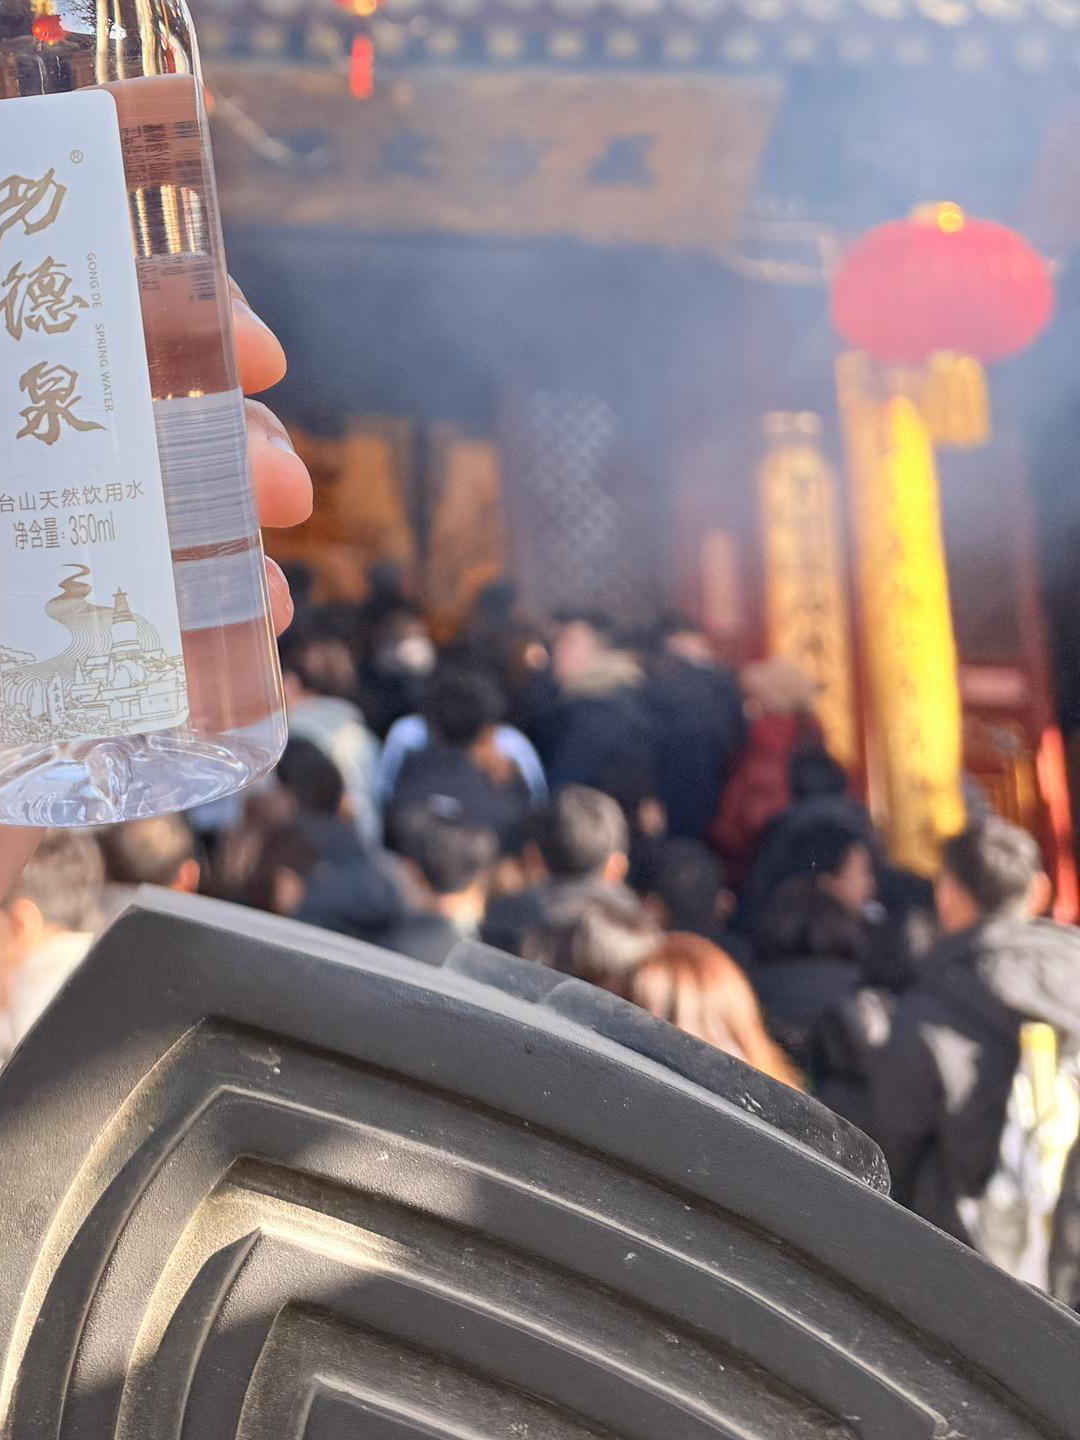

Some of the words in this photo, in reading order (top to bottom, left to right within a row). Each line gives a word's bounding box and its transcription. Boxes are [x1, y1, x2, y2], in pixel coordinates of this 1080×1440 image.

[86, 252, 99, 289] GONG
[92, 293, 103, 309] DE
[95, 323, 109, 368] SPRING
[101, 371, 114, 413] WATER
